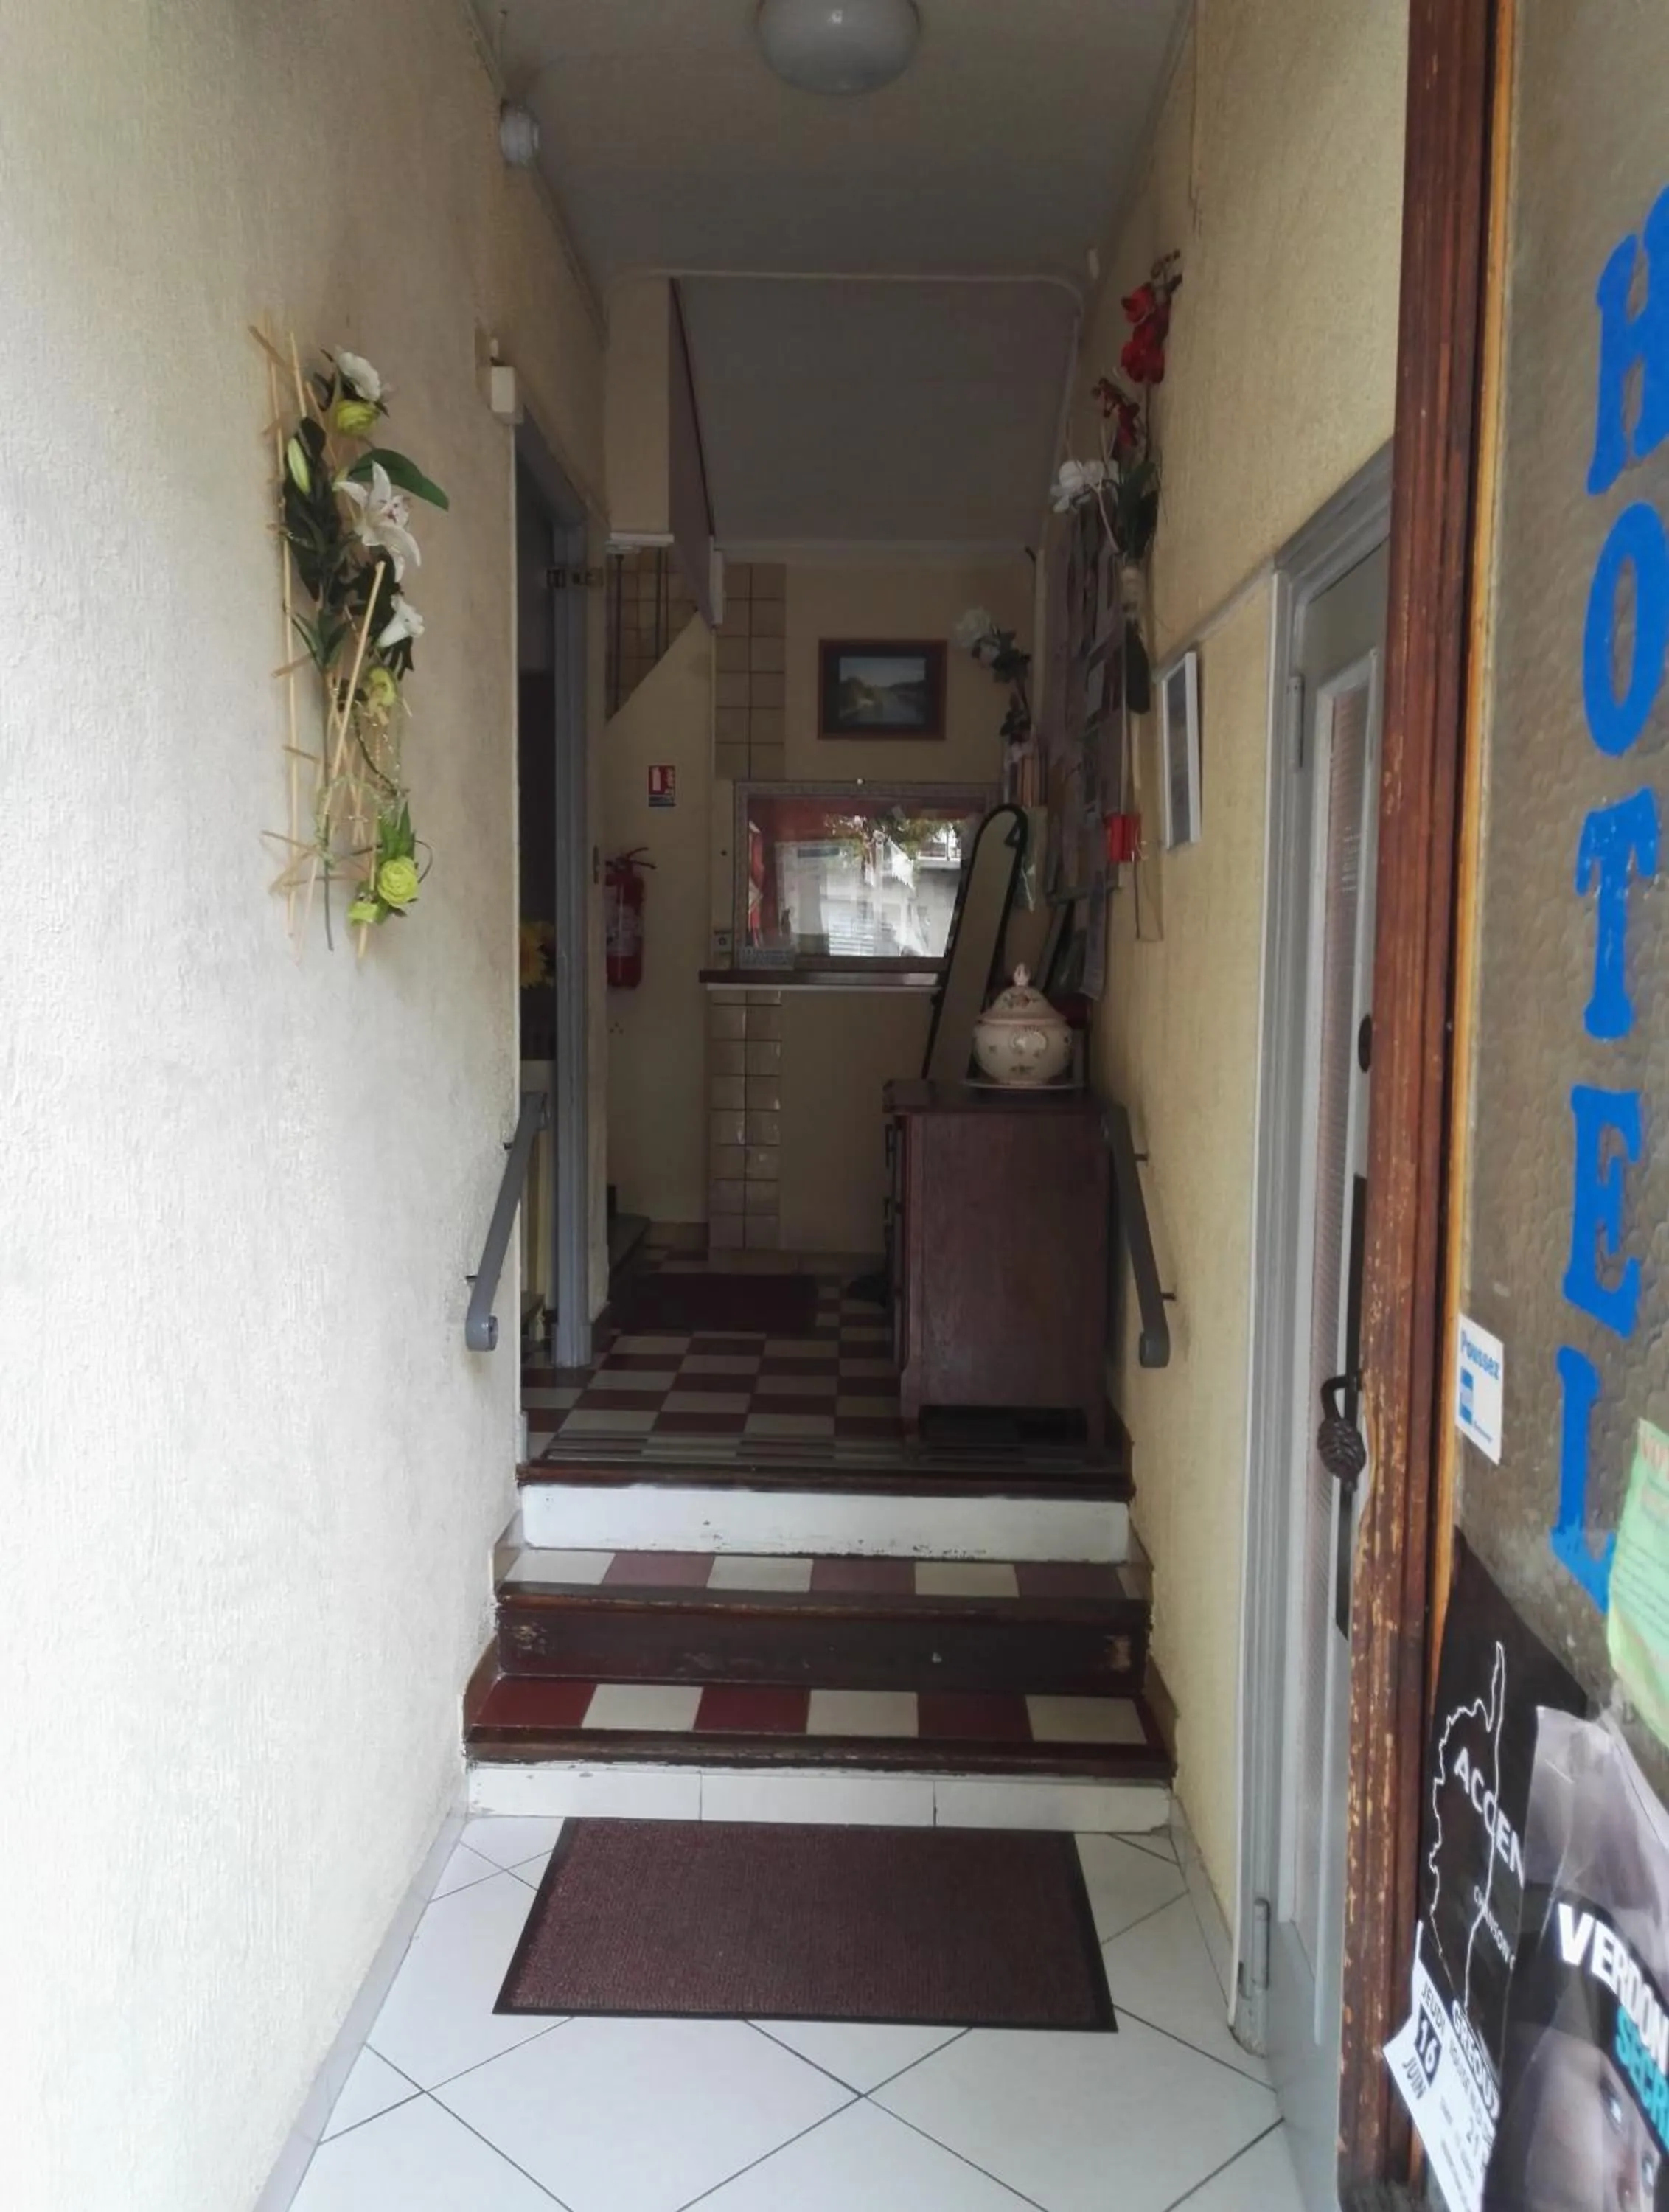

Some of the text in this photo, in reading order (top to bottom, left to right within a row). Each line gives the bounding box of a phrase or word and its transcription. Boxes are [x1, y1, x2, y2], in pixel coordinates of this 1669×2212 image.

[1420, 1982, 1446, 2037] JEUDI
[1418, 2020, 1438, 2074] 16
[1401, 2053, 1427, 2101] JUIN
